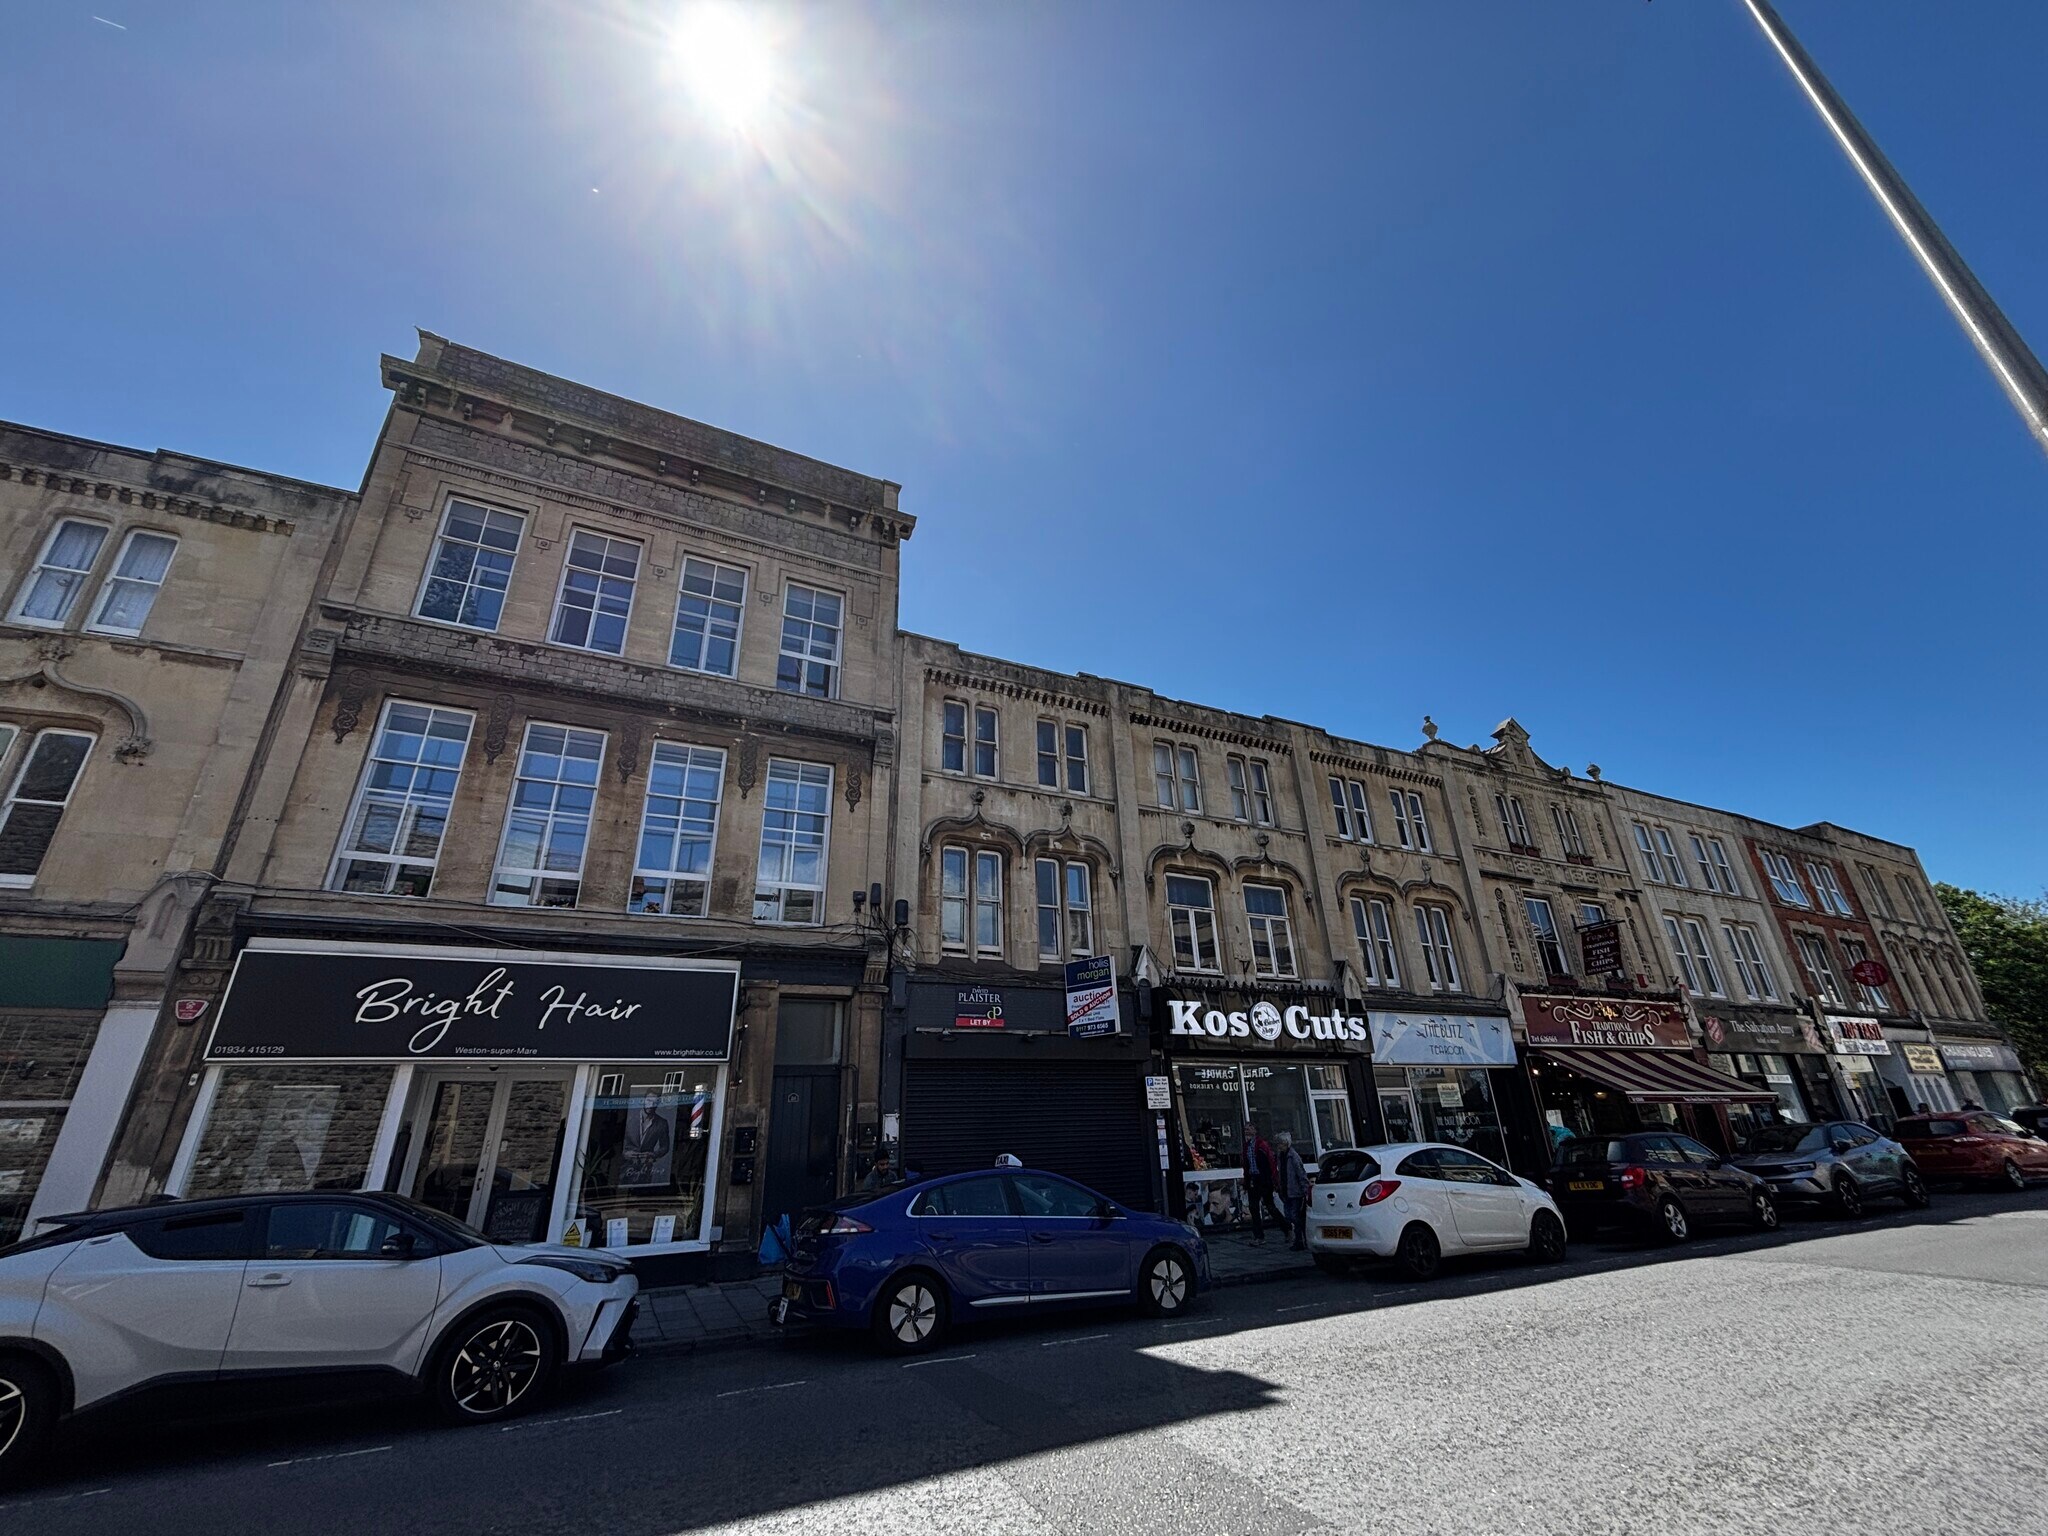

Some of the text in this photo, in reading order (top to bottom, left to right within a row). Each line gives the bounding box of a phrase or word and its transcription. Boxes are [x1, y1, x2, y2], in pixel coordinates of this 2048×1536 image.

[1592, 947, 1611, 956] FISH
[1088, 959, 1109, 970] hollis
[1591, 958, 1614, 967] CHIPS
[1077, 968, 1110, 980] morgan
[958, 992, 1002, 1004] PLAISTER
[1073, 990, 1104, 1003] auctio
[356, 967, 642, 1053] Bright Hair
[1070, 1009, 1084, 1021] SOLD
[1089, 991, 1112, 1009] AUCTION
[1166, 1000, 1367, 1041] Kos Cuts
[1591, 1021, 1632, 1032] TRADITIONAL
[1569, 1020, 1656, 1046] FISH & CHIPS
[1729, 1020, 1745, 1032] The
[1745, 1020, 1777, 1034] Salvation
[214, 1045, 285, 1054] 01934 415129
[454, 1046, 538, 1055] Weston-super-Mare
[654, 1049, 724, 1058] www.brighthair.co.uk
